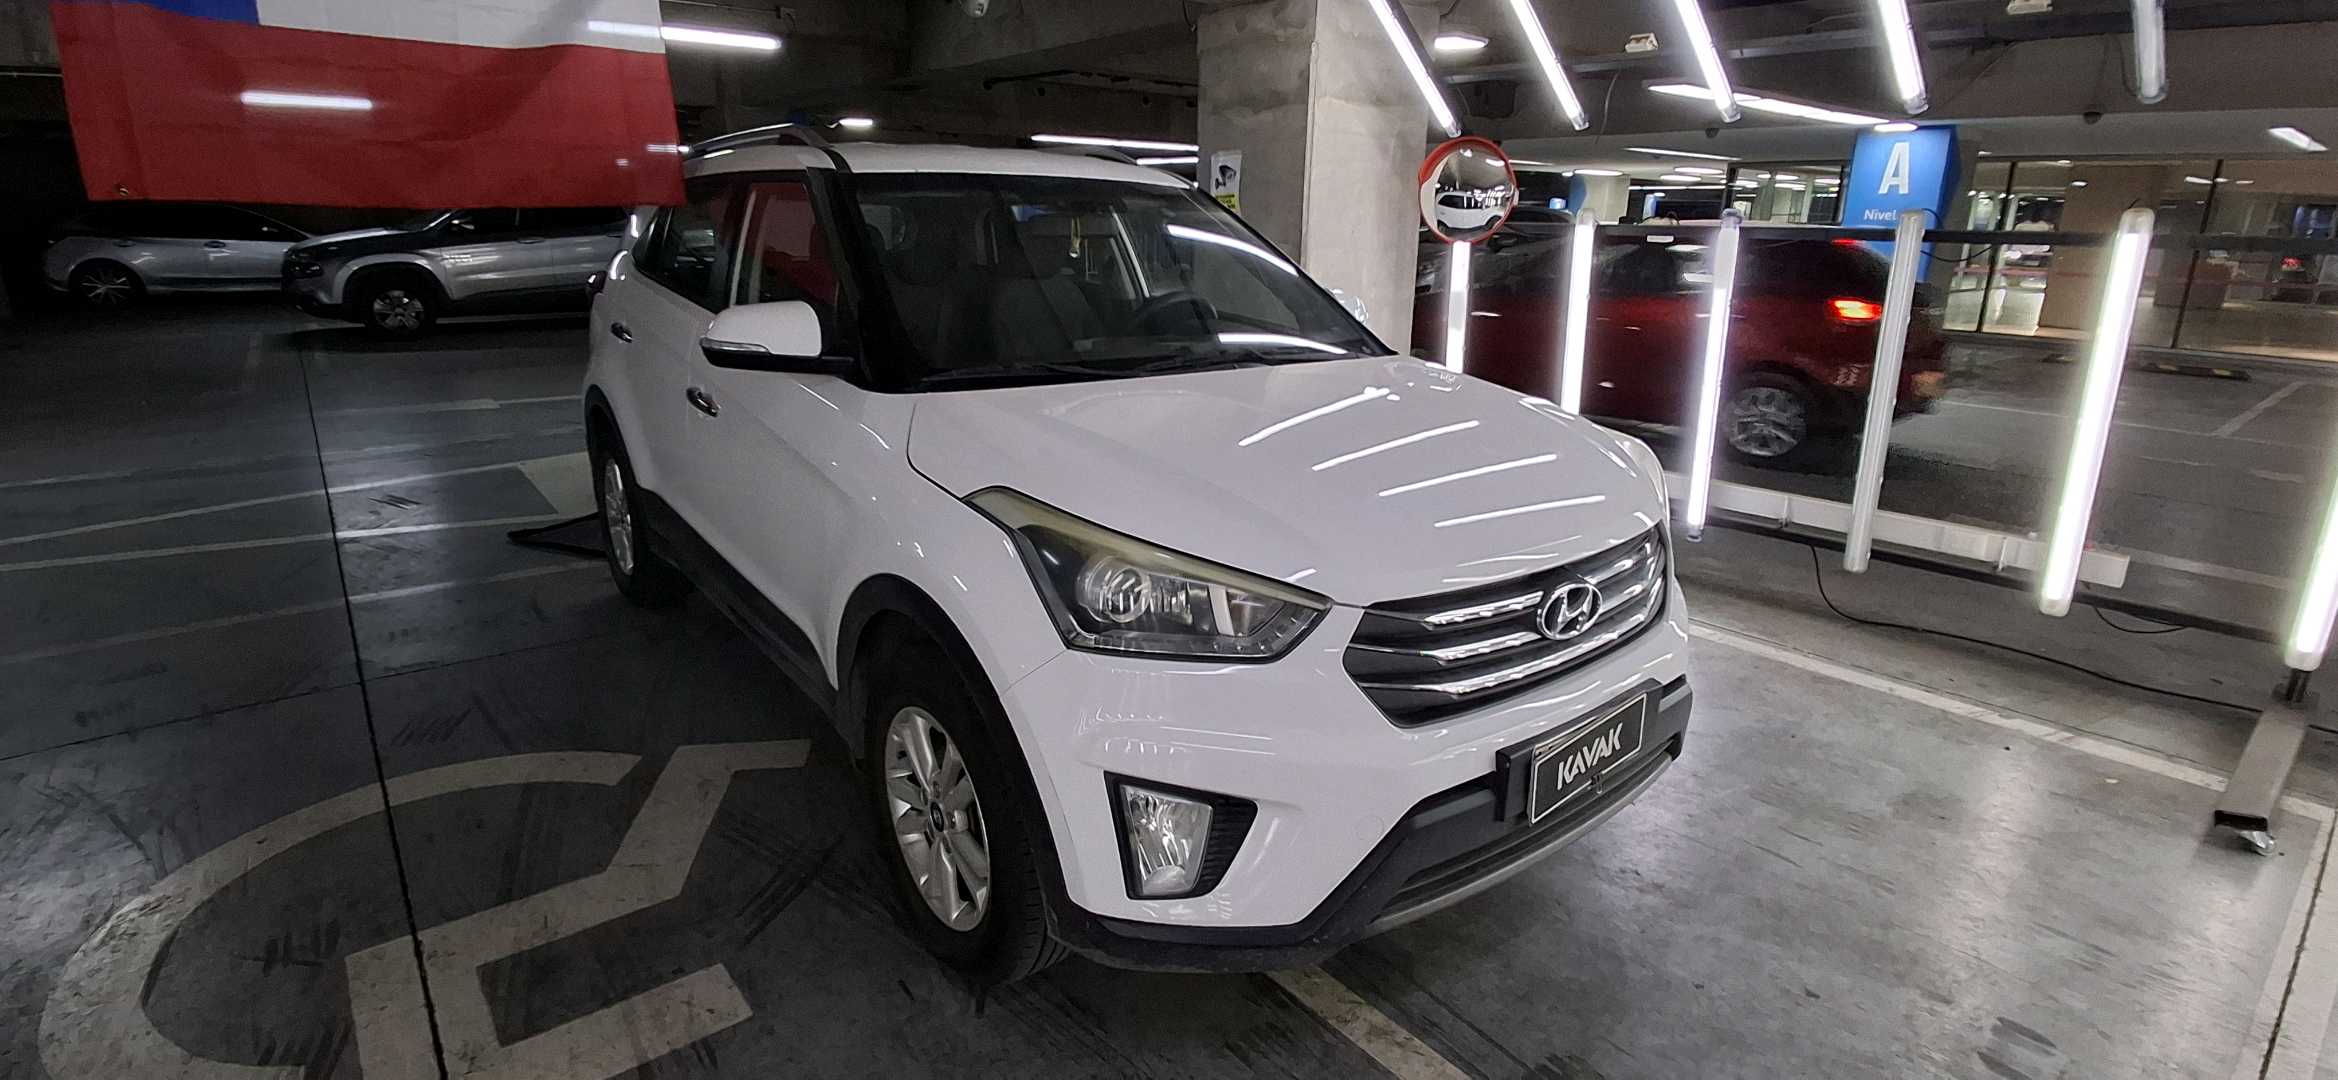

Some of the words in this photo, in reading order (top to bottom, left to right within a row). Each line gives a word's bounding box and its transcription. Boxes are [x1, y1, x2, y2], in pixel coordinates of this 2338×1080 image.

[1878, 142, 1910, 194] A
[1863, 209, 1897, 221] Nivel
[1557, 722, 1623, 790] KAVAK
